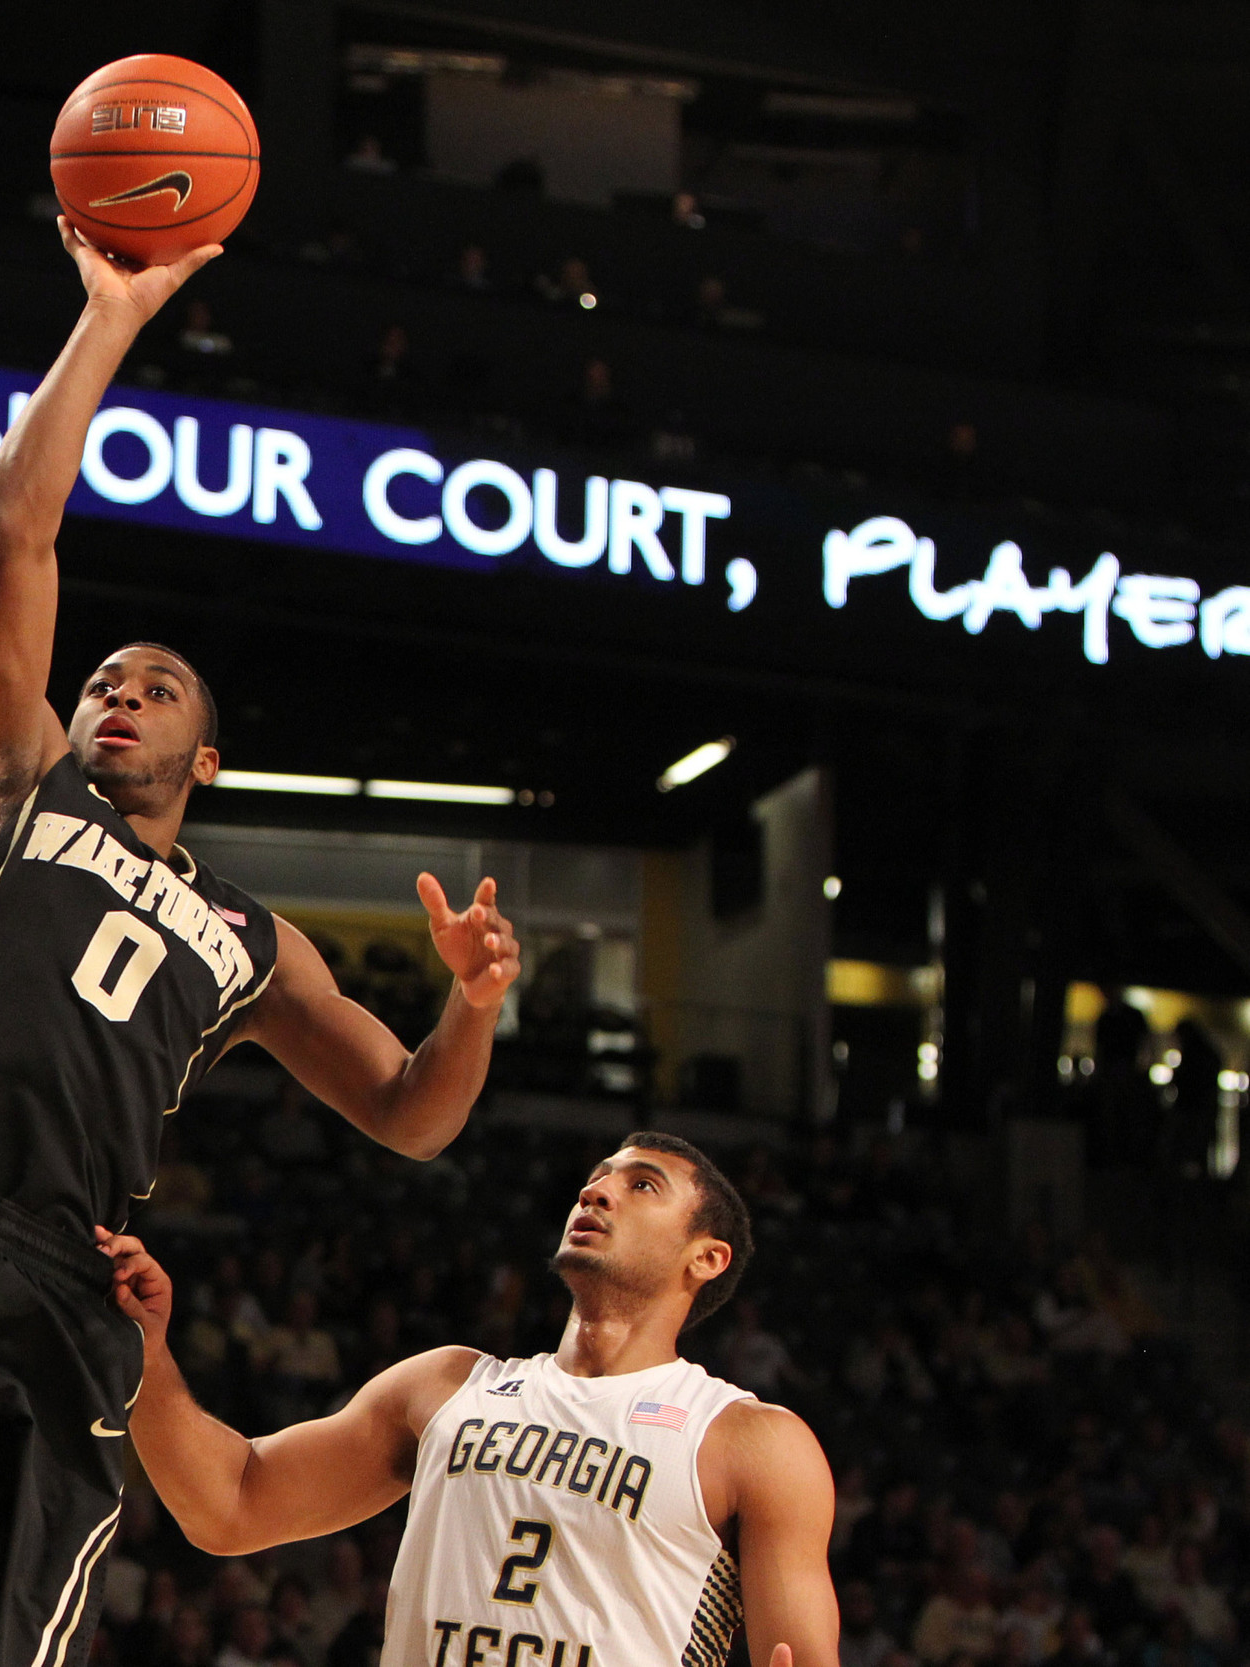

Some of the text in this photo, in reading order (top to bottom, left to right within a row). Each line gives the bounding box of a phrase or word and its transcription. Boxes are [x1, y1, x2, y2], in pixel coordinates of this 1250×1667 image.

[81, 407, 322, 530] OUR
[363, 448, 757, 612] COURT,
[22, 812, 254, 1011] WAKE FOREST
[71, 910, 168, 1022] 0
[446, 1418, 653, 1524] GEORGIA
[490, 1517, 555, 1608] 2
